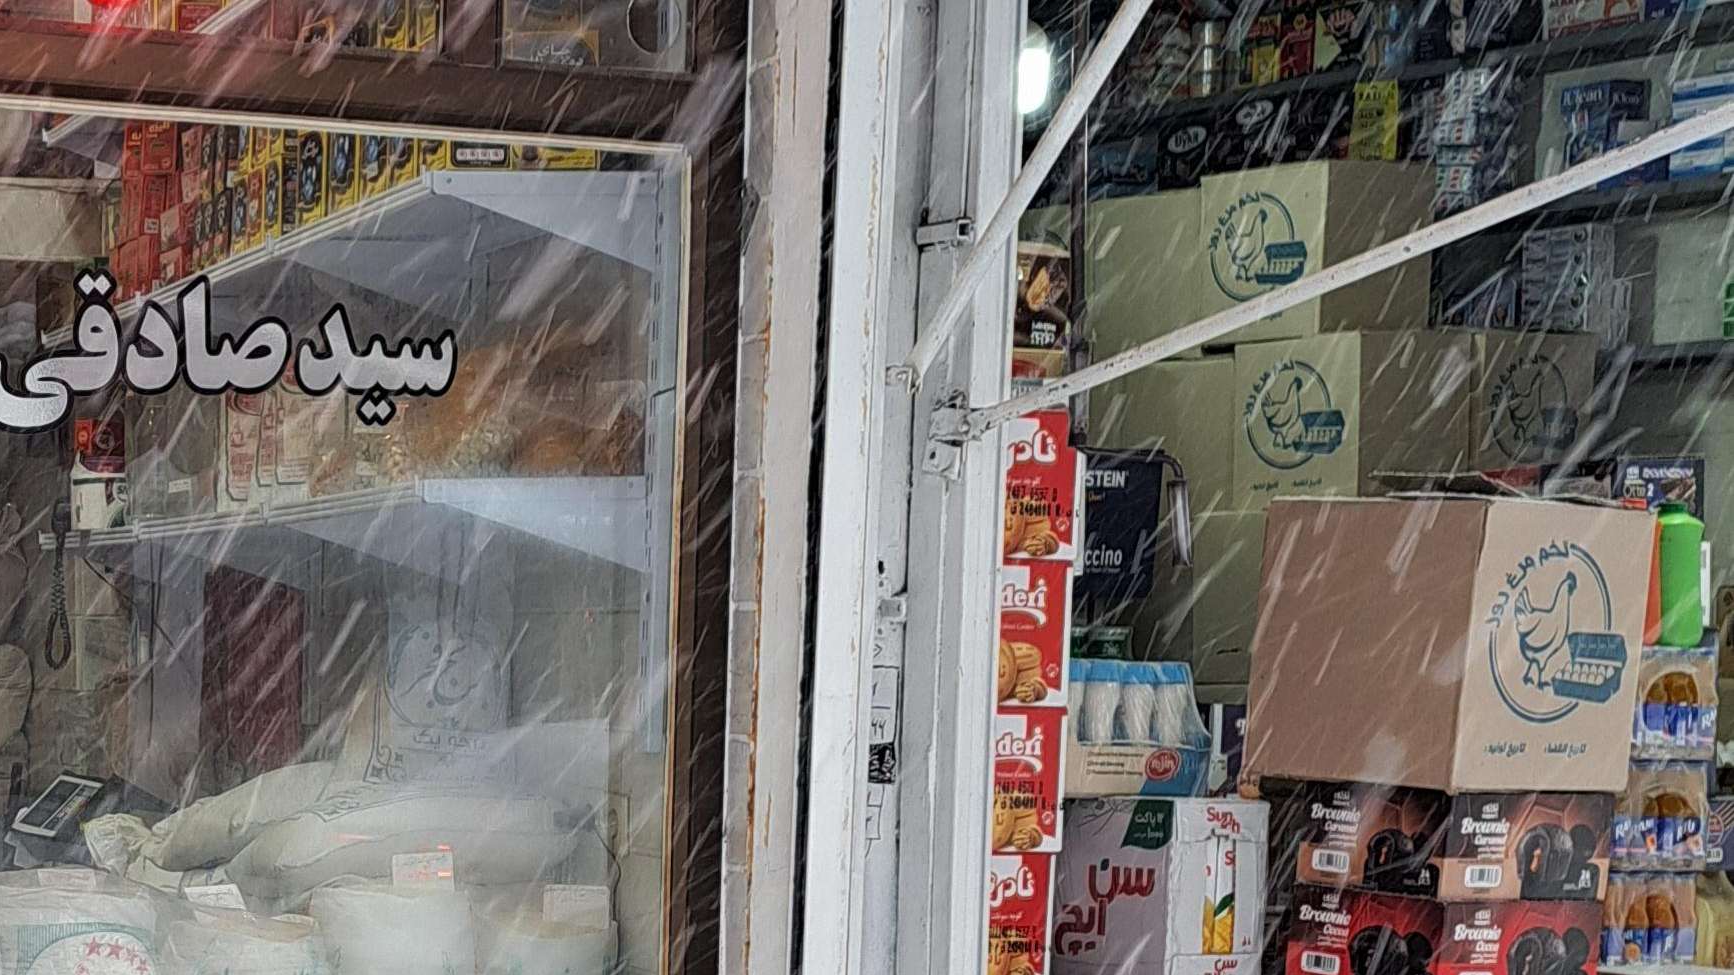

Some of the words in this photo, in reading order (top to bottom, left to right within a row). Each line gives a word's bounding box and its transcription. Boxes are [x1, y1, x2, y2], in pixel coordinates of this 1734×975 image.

[294, 302, 458, 427] سید
[1085, 470, 1126, 488] STEIN
[1084, 543, 1123, 566] ccino
[1001, 577, 1048, 609] deri
[996, 725, 1044, 756] deri
[1087, 857, 1156, 904] سن
